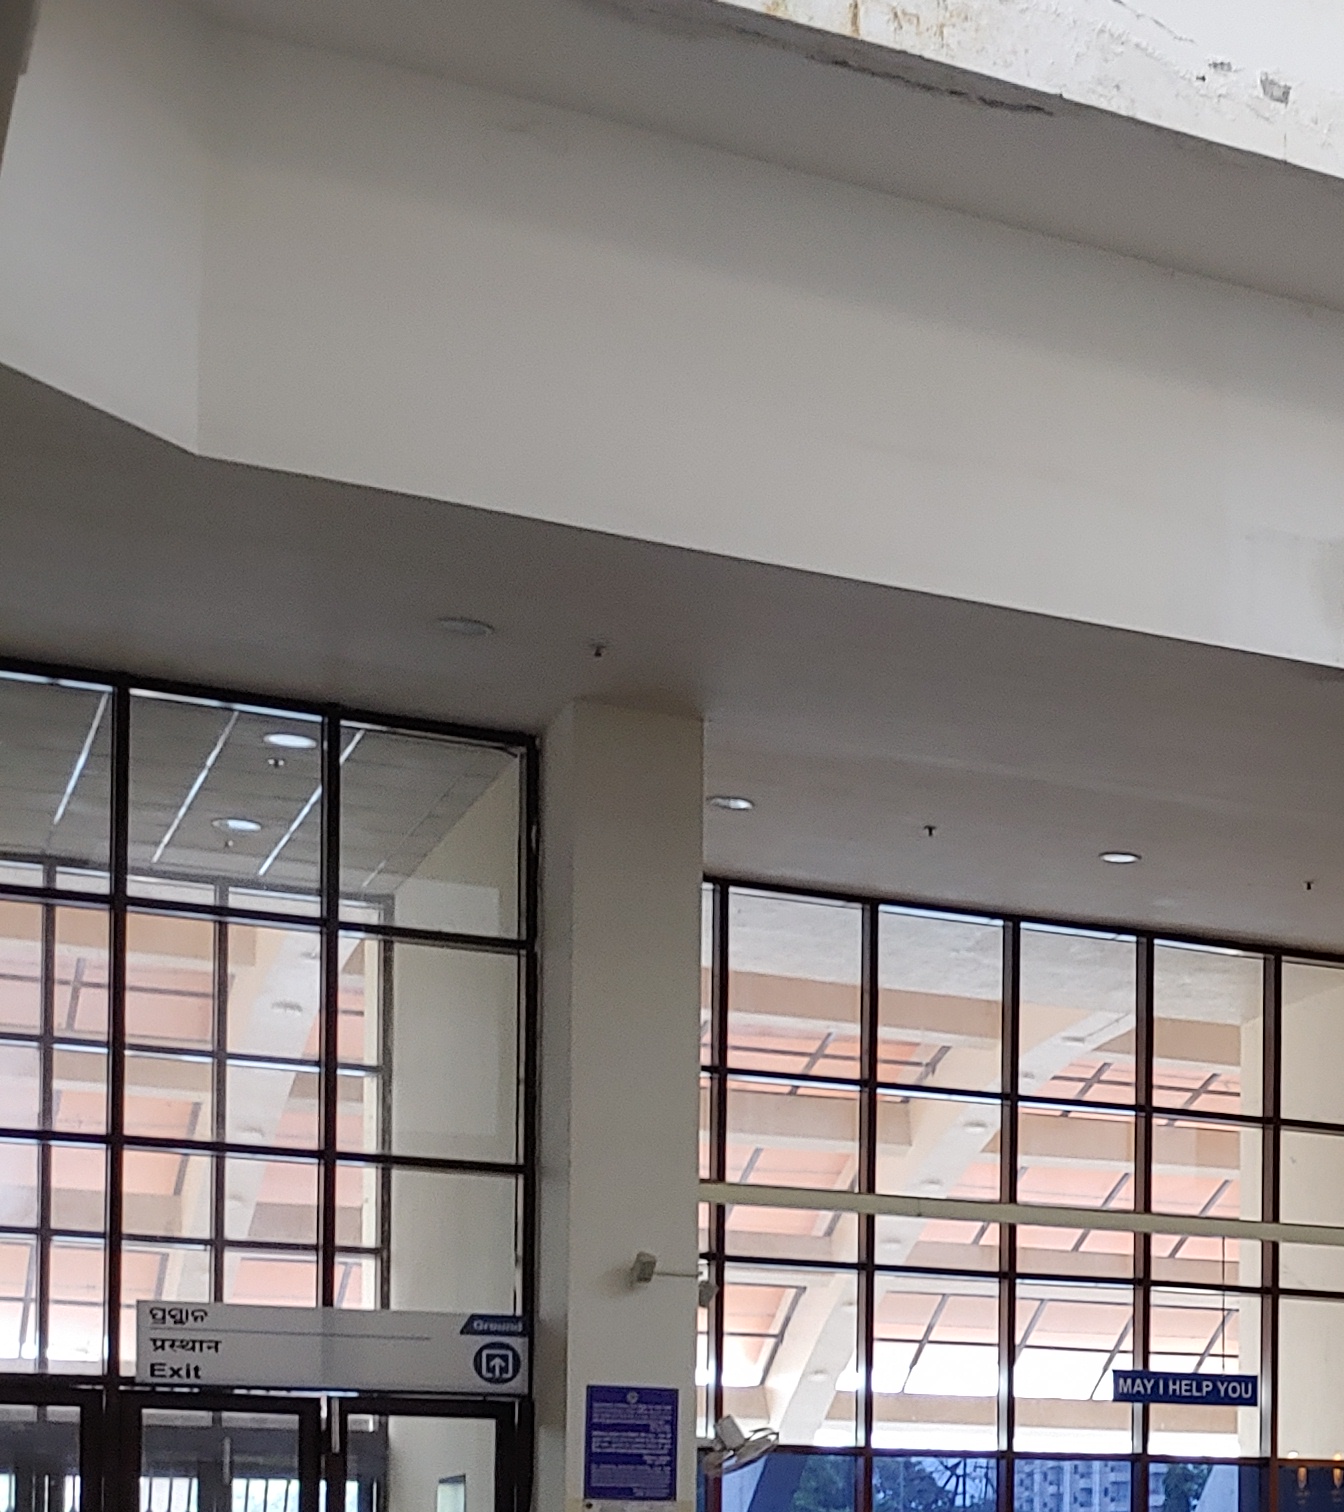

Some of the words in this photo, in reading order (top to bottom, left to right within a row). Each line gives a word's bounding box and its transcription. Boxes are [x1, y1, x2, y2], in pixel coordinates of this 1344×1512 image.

[149, 1337, 222, 1353] प्रस्थान
[149, 1362, 202, 1380] Exit
[1118, 1377, 1155, 1394] MAY
[1158, 1378, 1164, 1395] I
[1168, 1379, 1213, 1396] HELP
[1217, 1381, 1252, 1399] YOU
